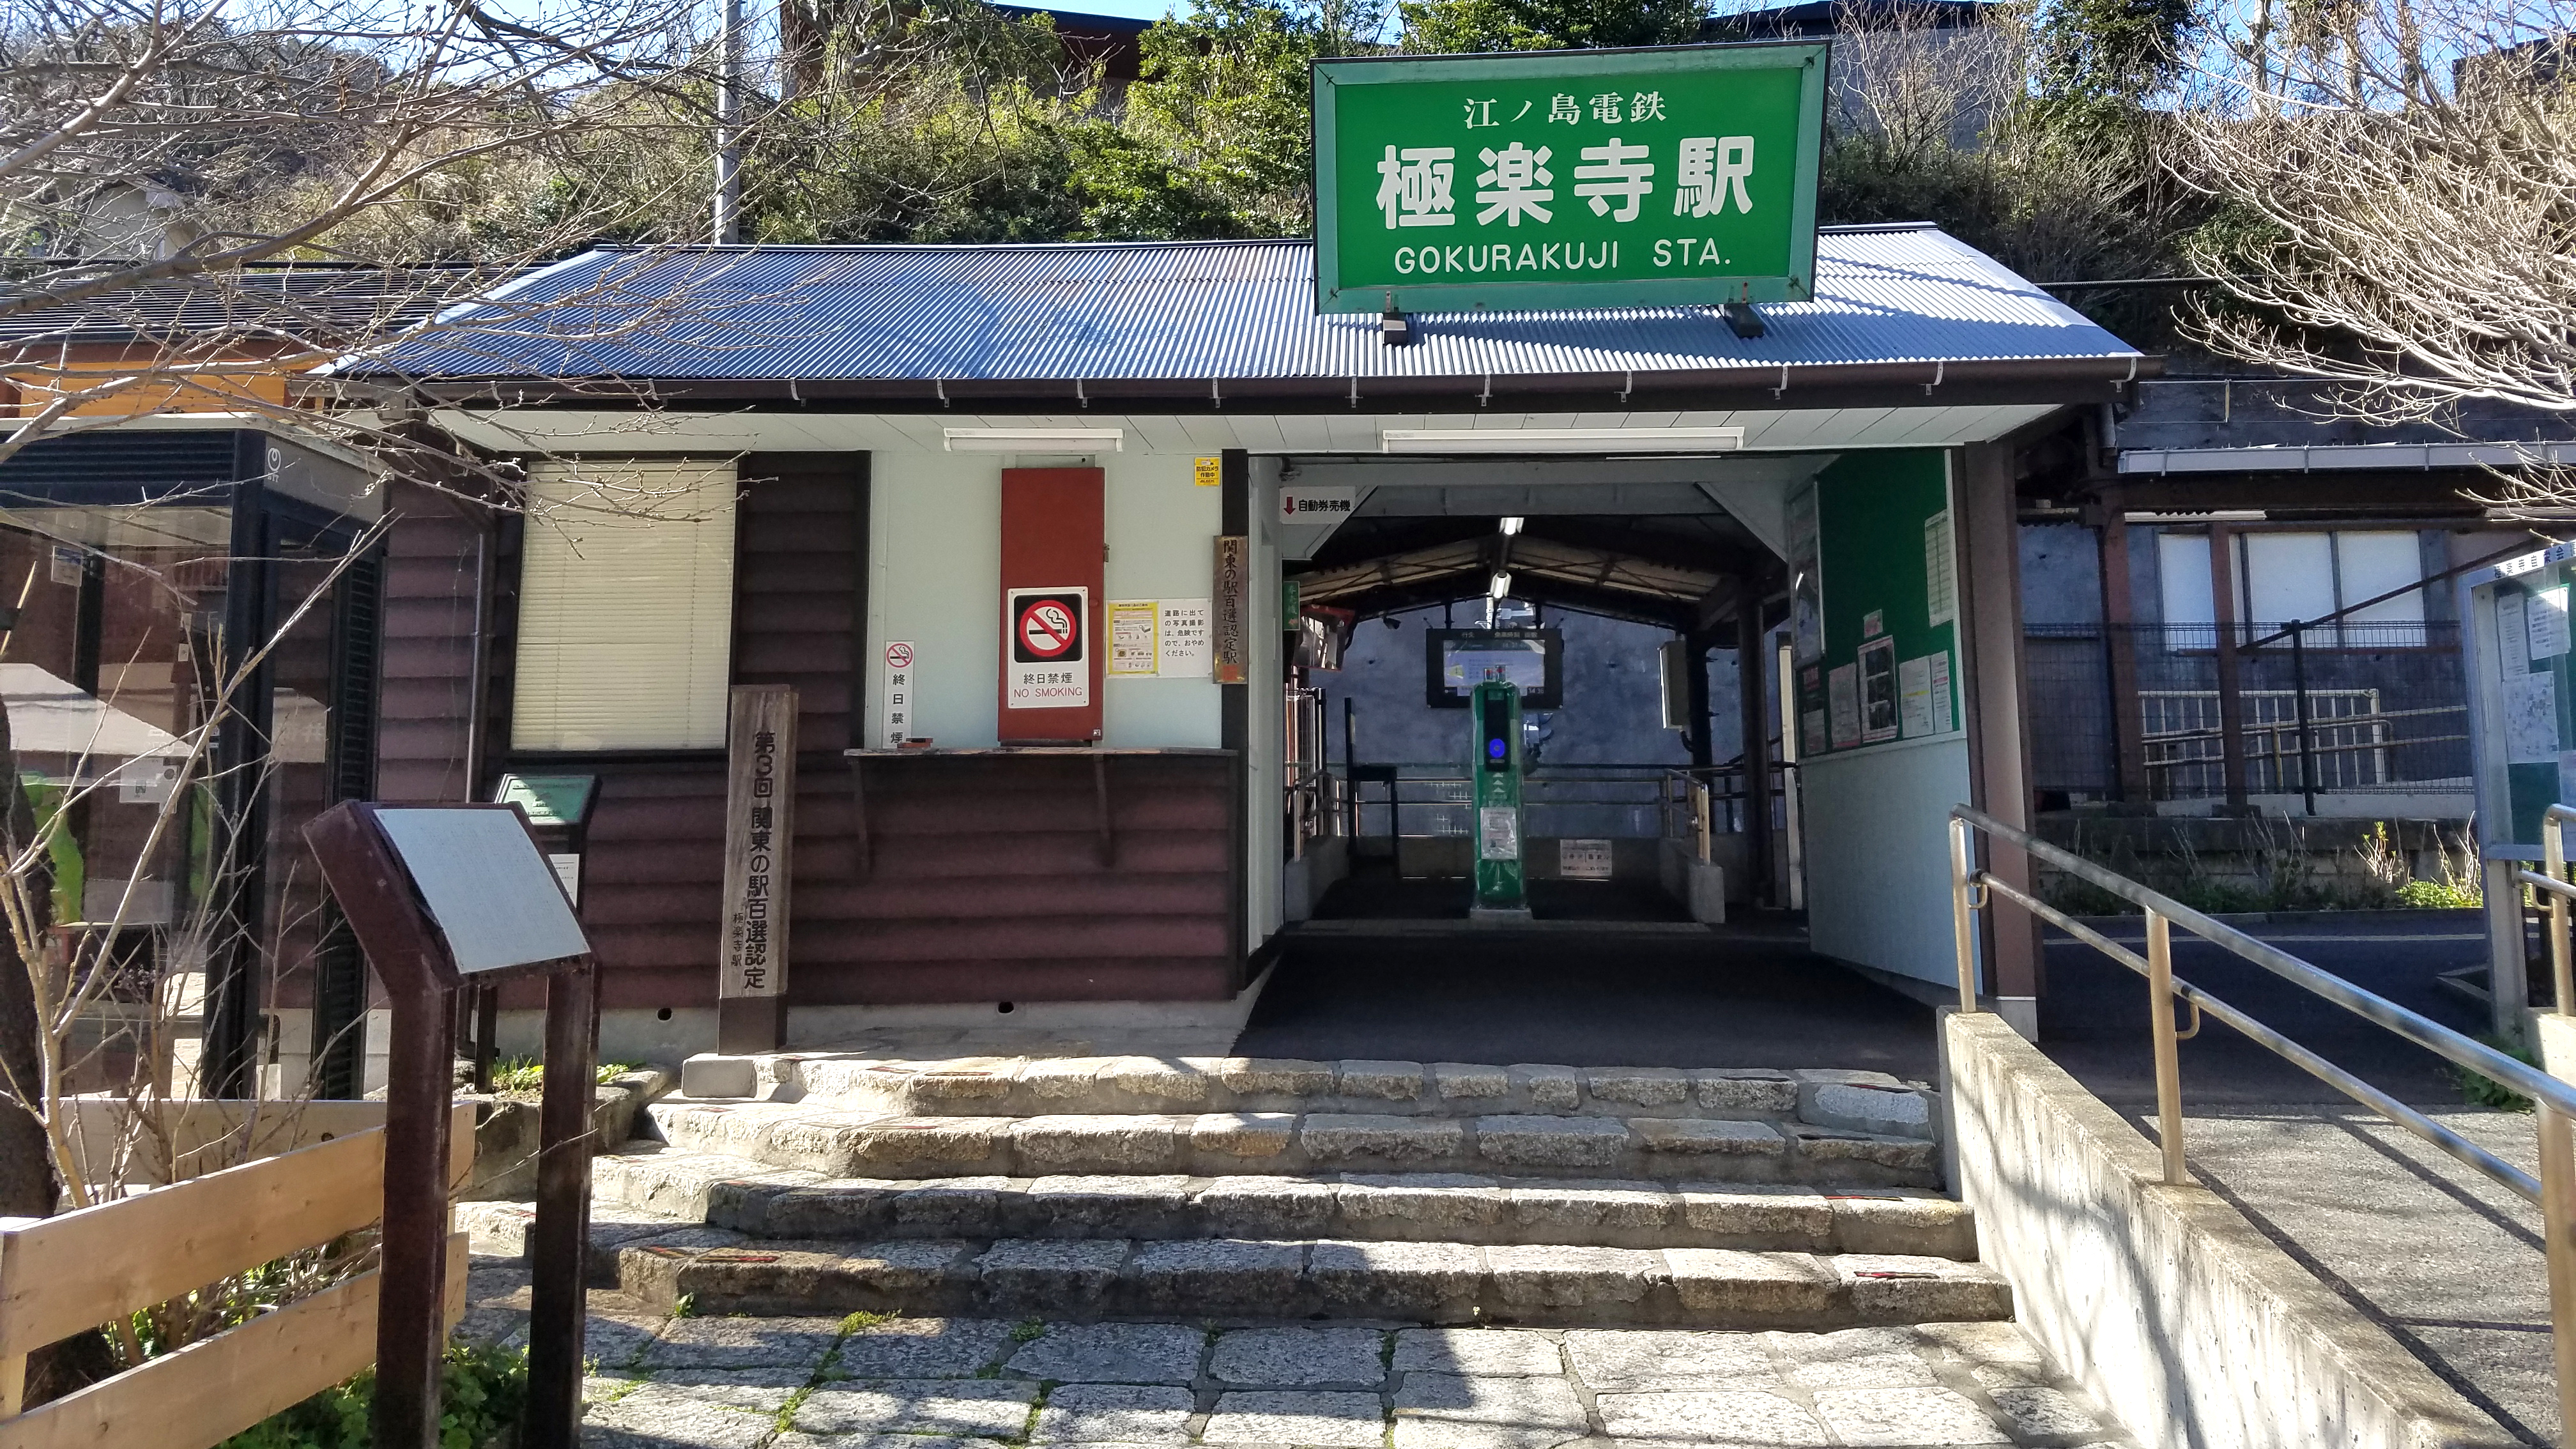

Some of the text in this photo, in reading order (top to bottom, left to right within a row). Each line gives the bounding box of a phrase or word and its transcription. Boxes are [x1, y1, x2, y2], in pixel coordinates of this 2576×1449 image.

[1463, 91, 1667, 130] 江ノ島電鉄
[1376, 135, 1754, 230] 極楽寺駅
[1395, 238, 1731, 275] GOKURAKUJI STA.
[1298, 499, 1351, 512] 自動券売機
[1164, 609, 1204, 617] 道路に出て
[1223, 539, 1238, 664] 関東の駅百選認定駅
[1013, 687, 1083, 698] NO SMOKING
[1023, 672, 1073, 685] 終日禁煙
[890, 673, 905, 744] 終日禁煙
[731, 912, 744, 967] 極楽寺駅
